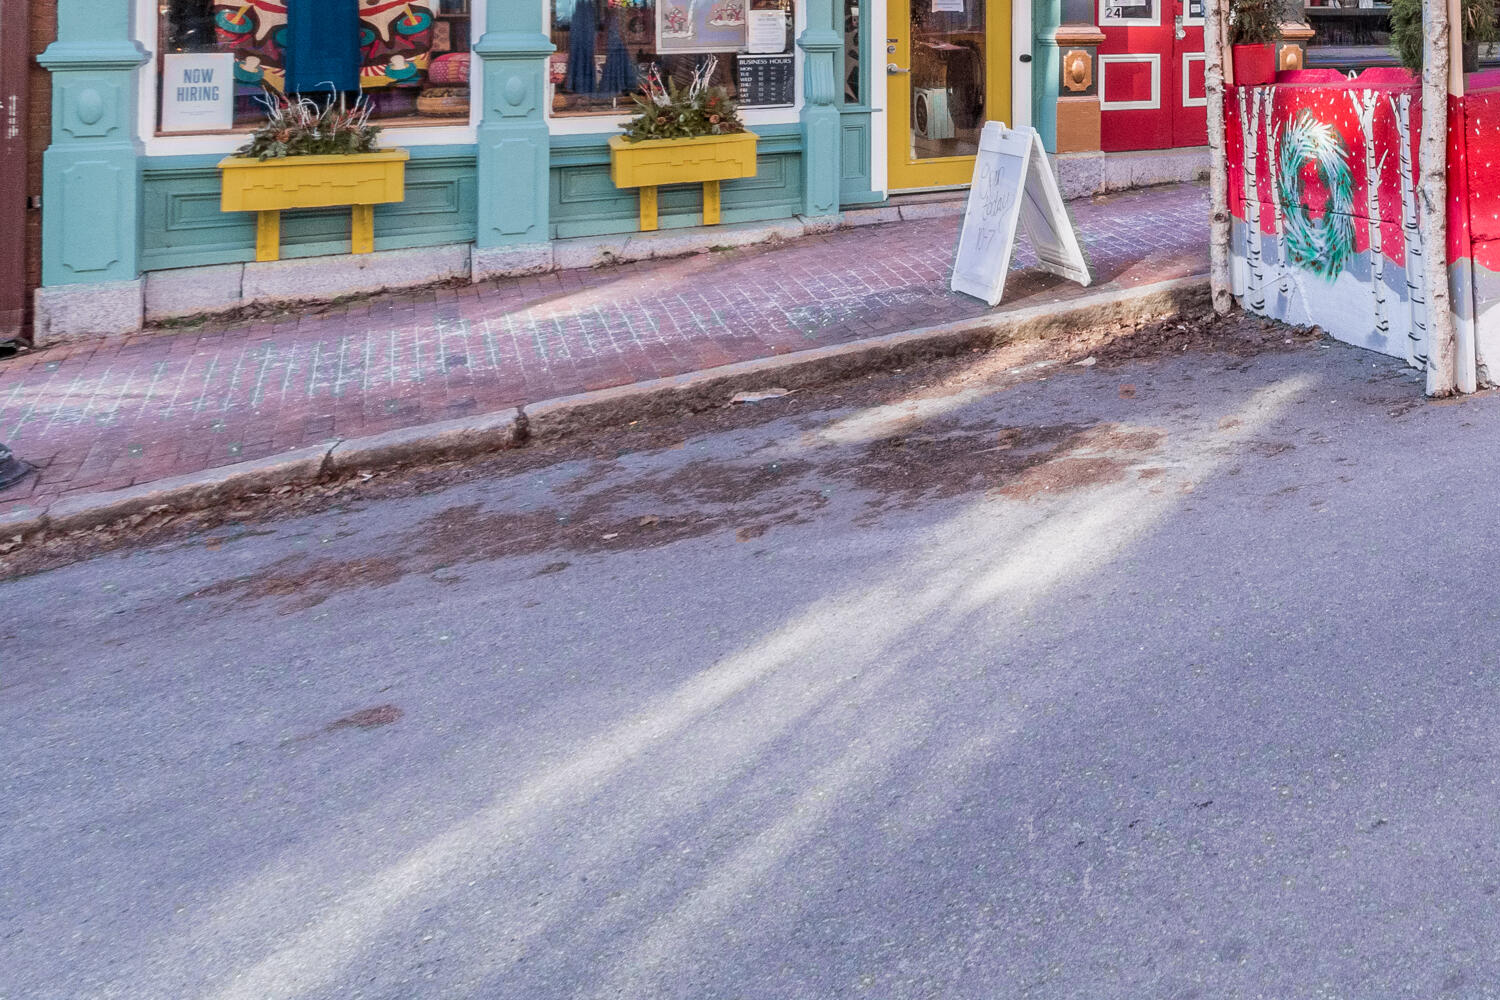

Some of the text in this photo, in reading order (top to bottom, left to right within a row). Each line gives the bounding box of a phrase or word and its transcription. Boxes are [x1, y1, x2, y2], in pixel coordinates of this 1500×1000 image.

[1105, 7, 1120, 18] 24
[183, 68, 214, 84] NOW
[176, 86, 220, 102] HIRING
